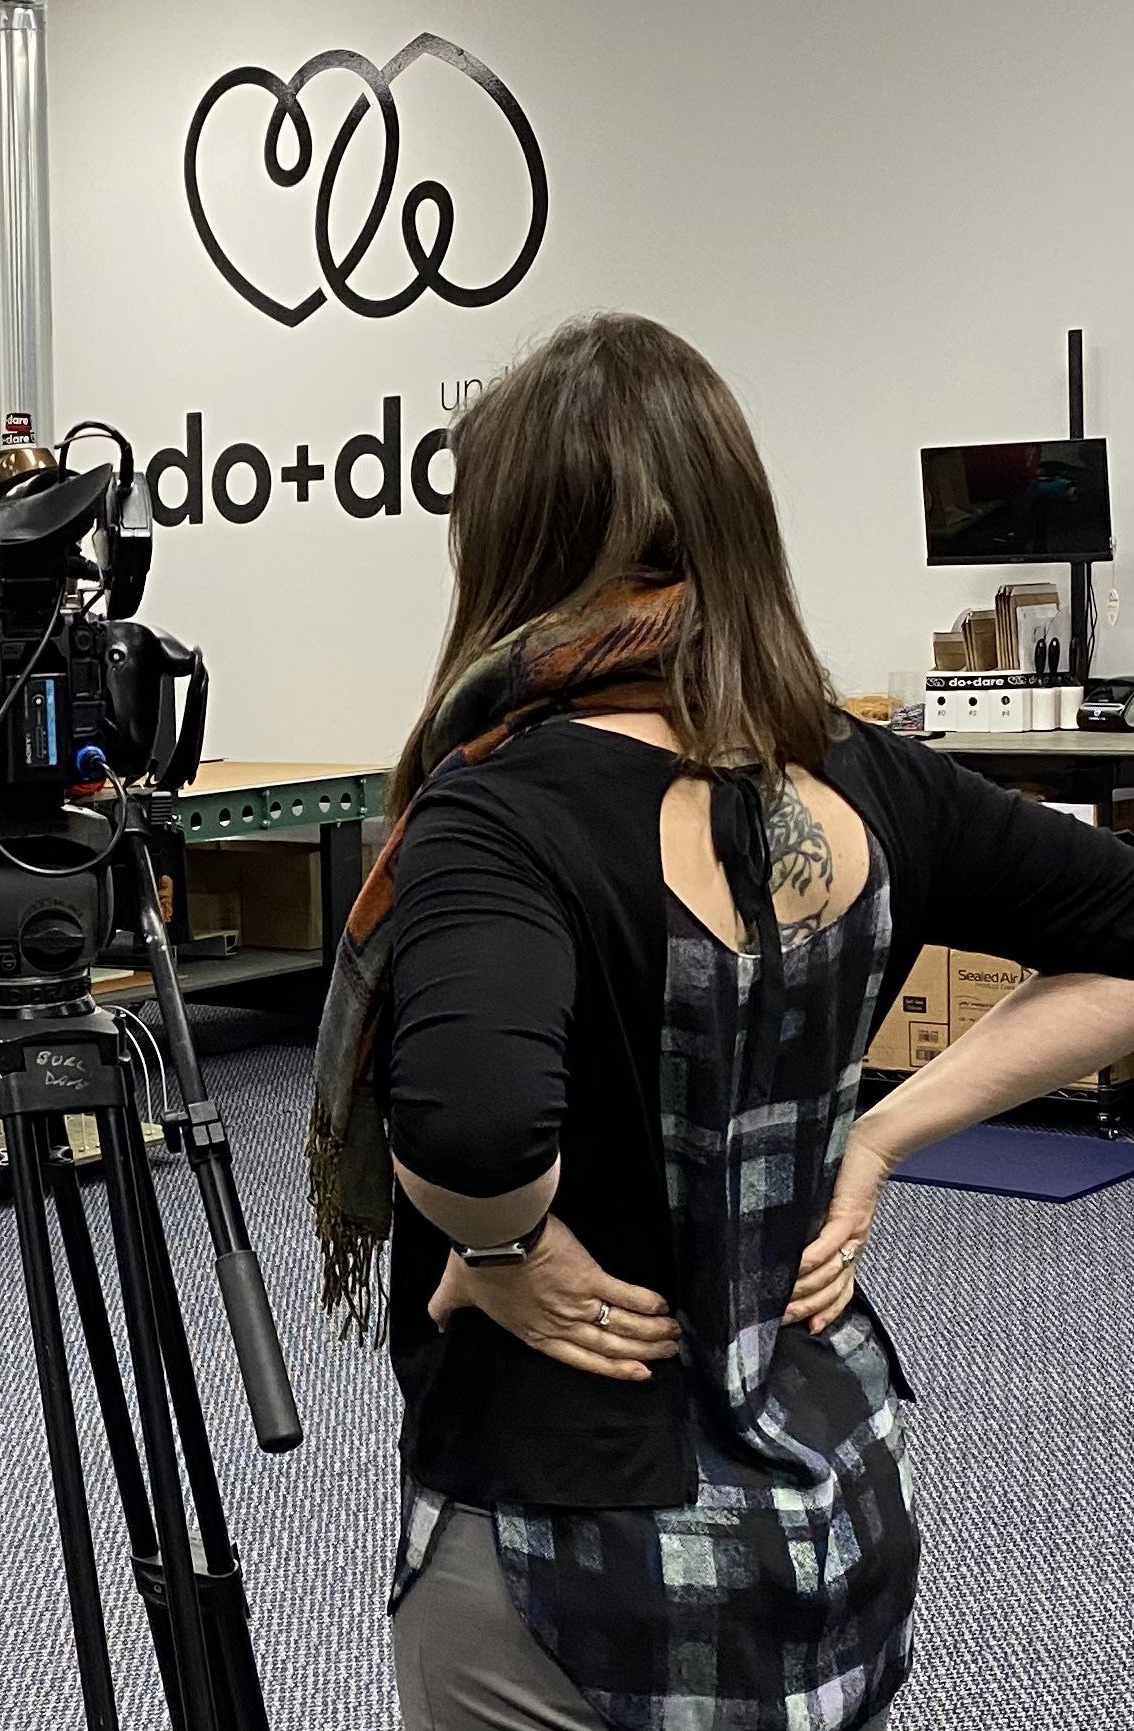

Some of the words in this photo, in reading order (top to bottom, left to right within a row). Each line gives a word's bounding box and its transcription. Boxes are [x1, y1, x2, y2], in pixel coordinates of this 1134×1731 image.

[948, 677, 1005, 687] do+dare
[958, 969, 999, 983] Sealed
[1000, 972, 1019, 984] Air
